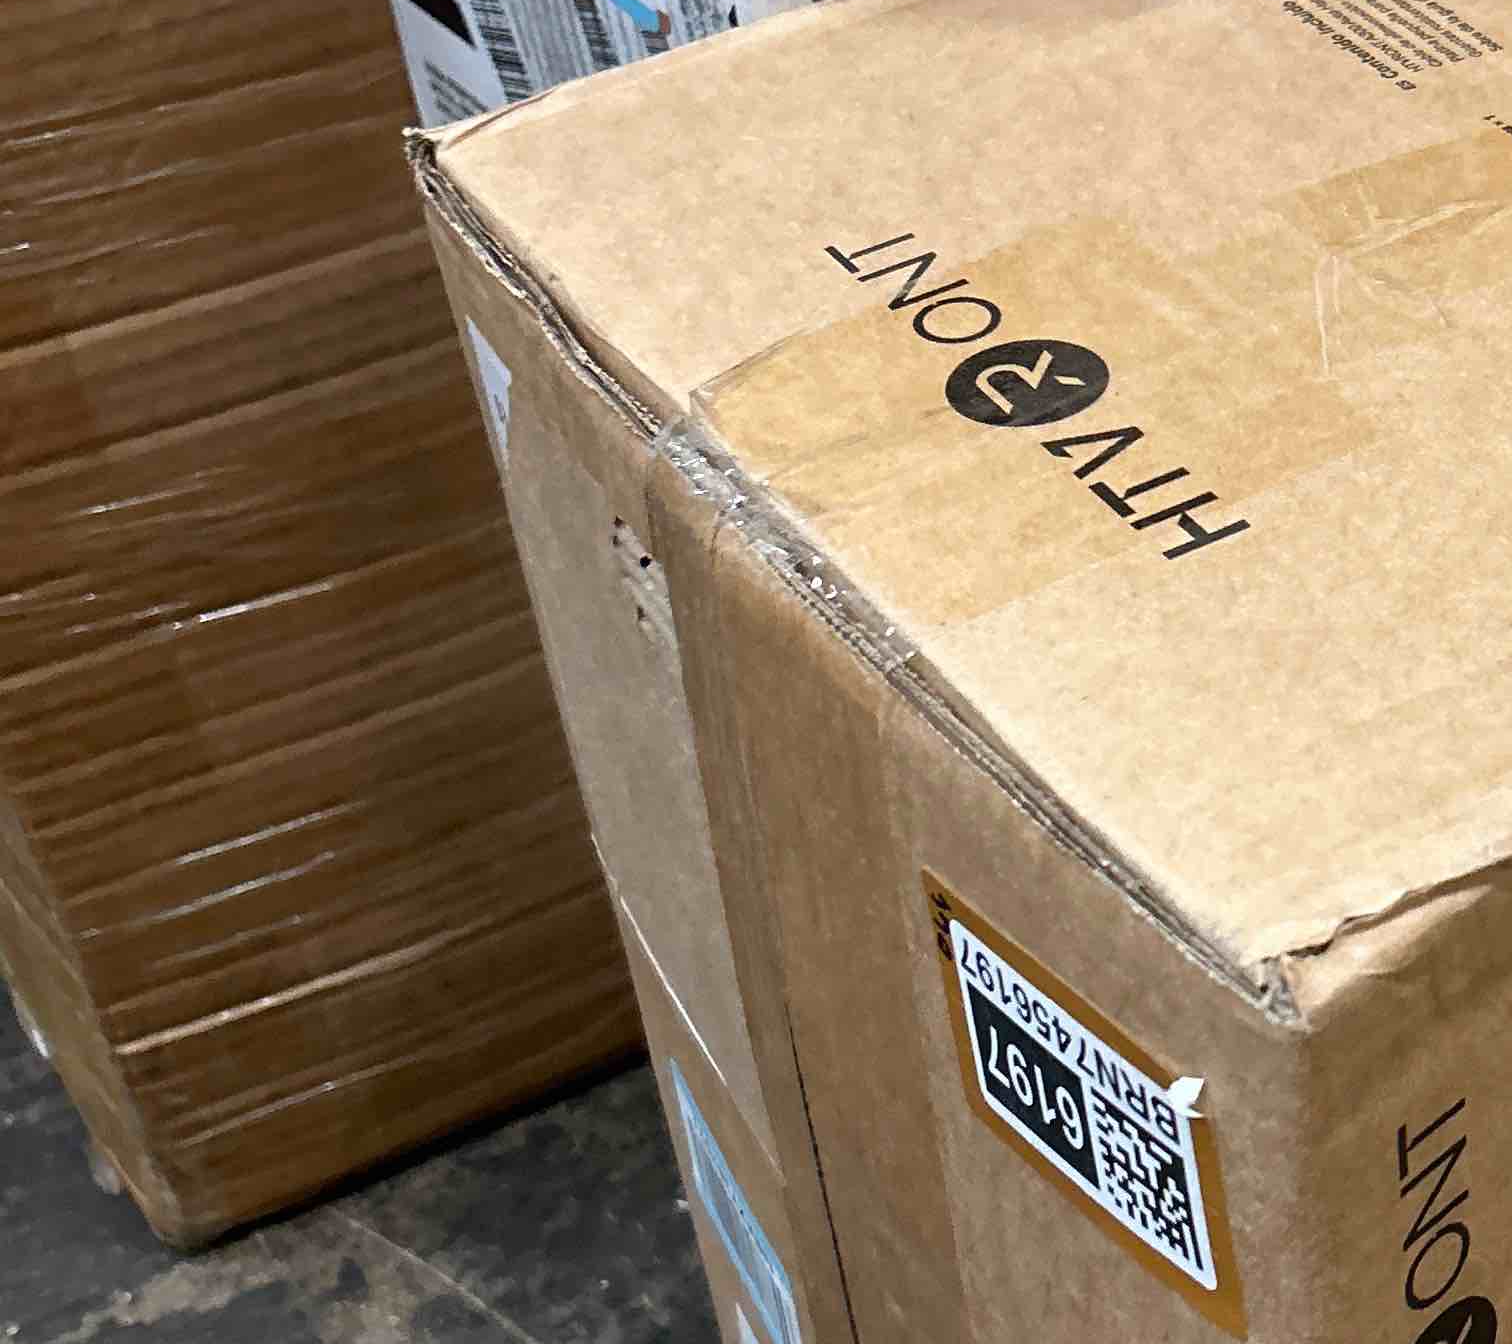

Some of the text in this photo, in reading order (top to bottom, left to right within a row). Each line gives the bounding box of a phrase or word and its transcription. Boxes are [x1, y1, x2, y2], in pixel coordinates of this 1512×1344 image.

[1330, 33, 1399, 79] Contenido
[824, 233, 1251, 560] HTVRONT
[960, 937, 1181, 1146] BRN7456197
[987, 1024, 1085, 1152] 6197
